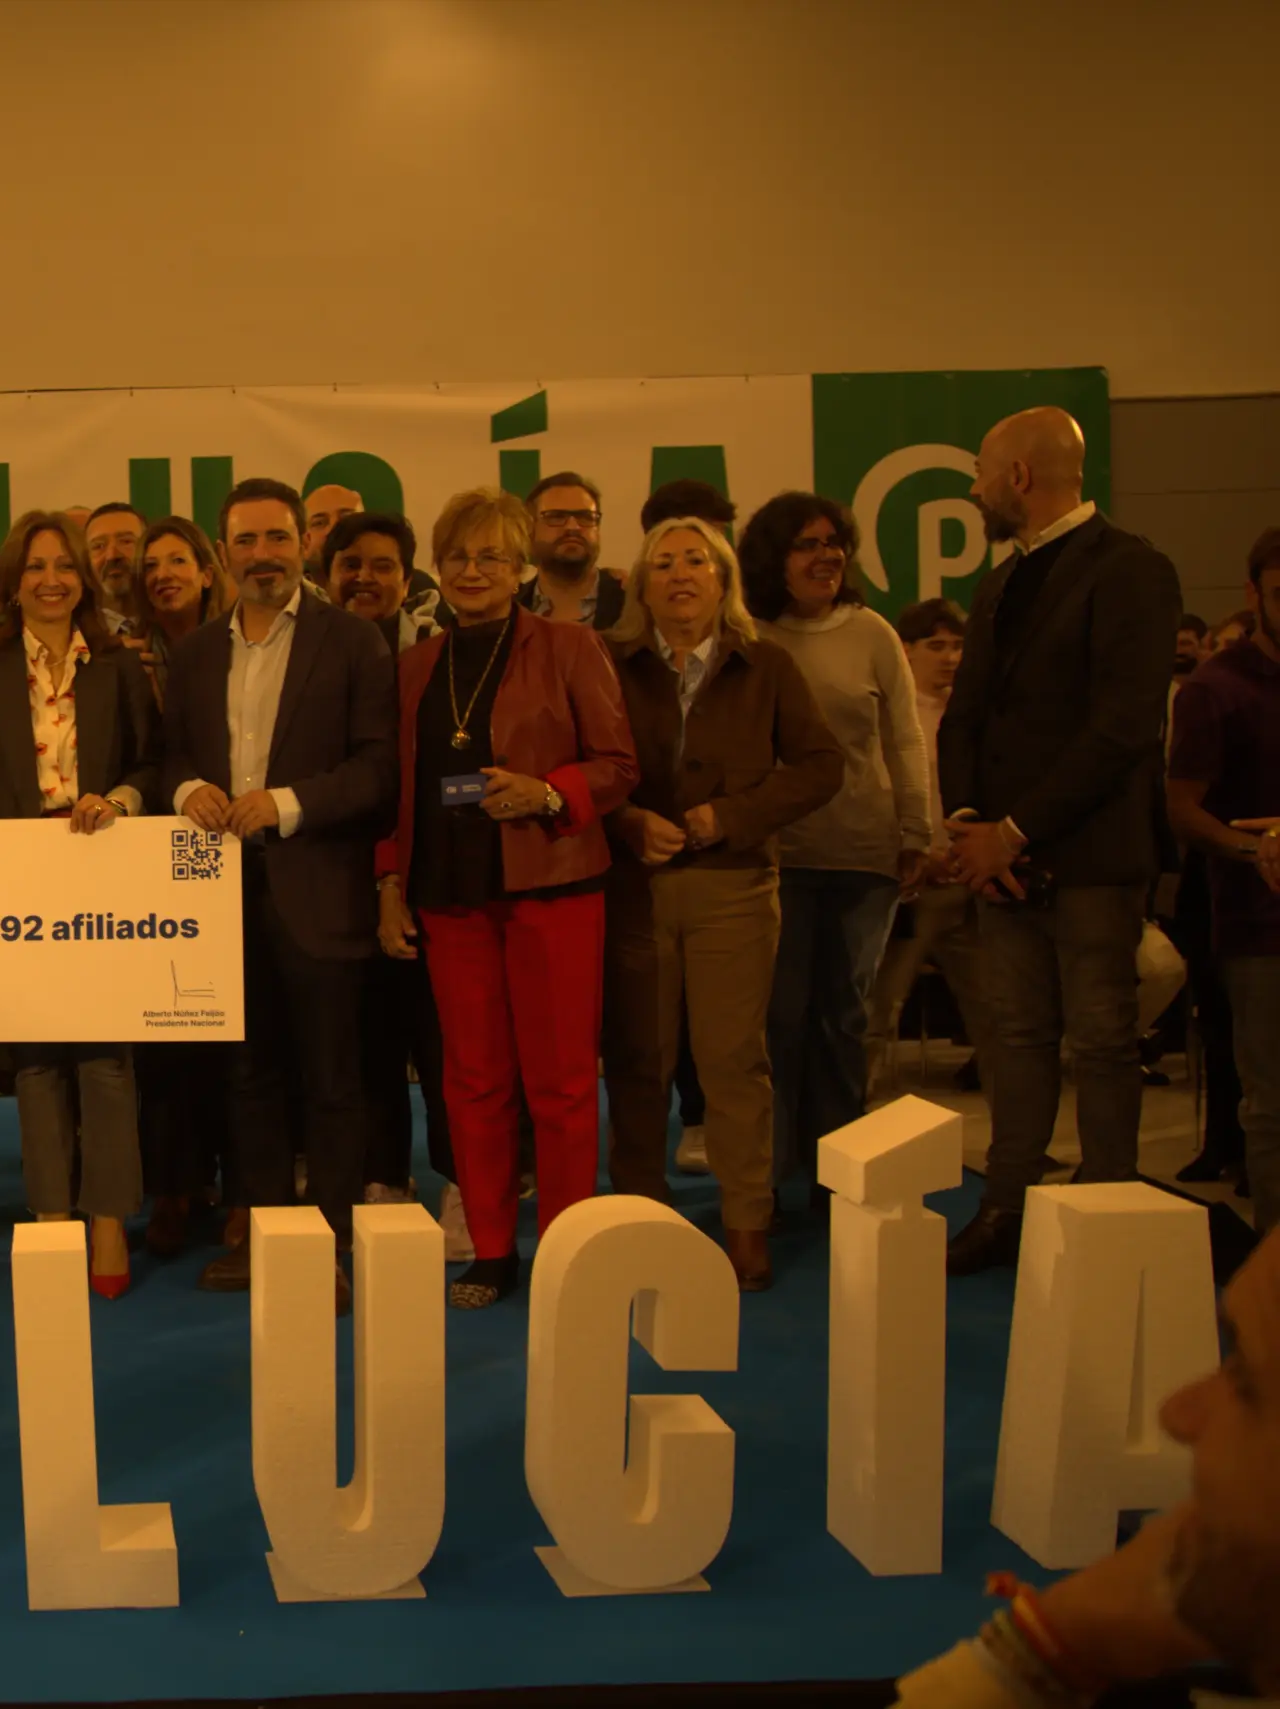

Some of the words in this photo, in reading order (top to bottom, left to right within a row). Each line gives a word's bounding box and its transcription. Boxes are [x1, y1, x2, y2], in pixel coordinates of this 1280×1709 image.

[51, 912, 200, 940] afiliados
[142, 1010, 172, 1018] Alberto
[145, 1019, 189, 1027] Presidente
[190, 1019, 226, 1027] Nacional
